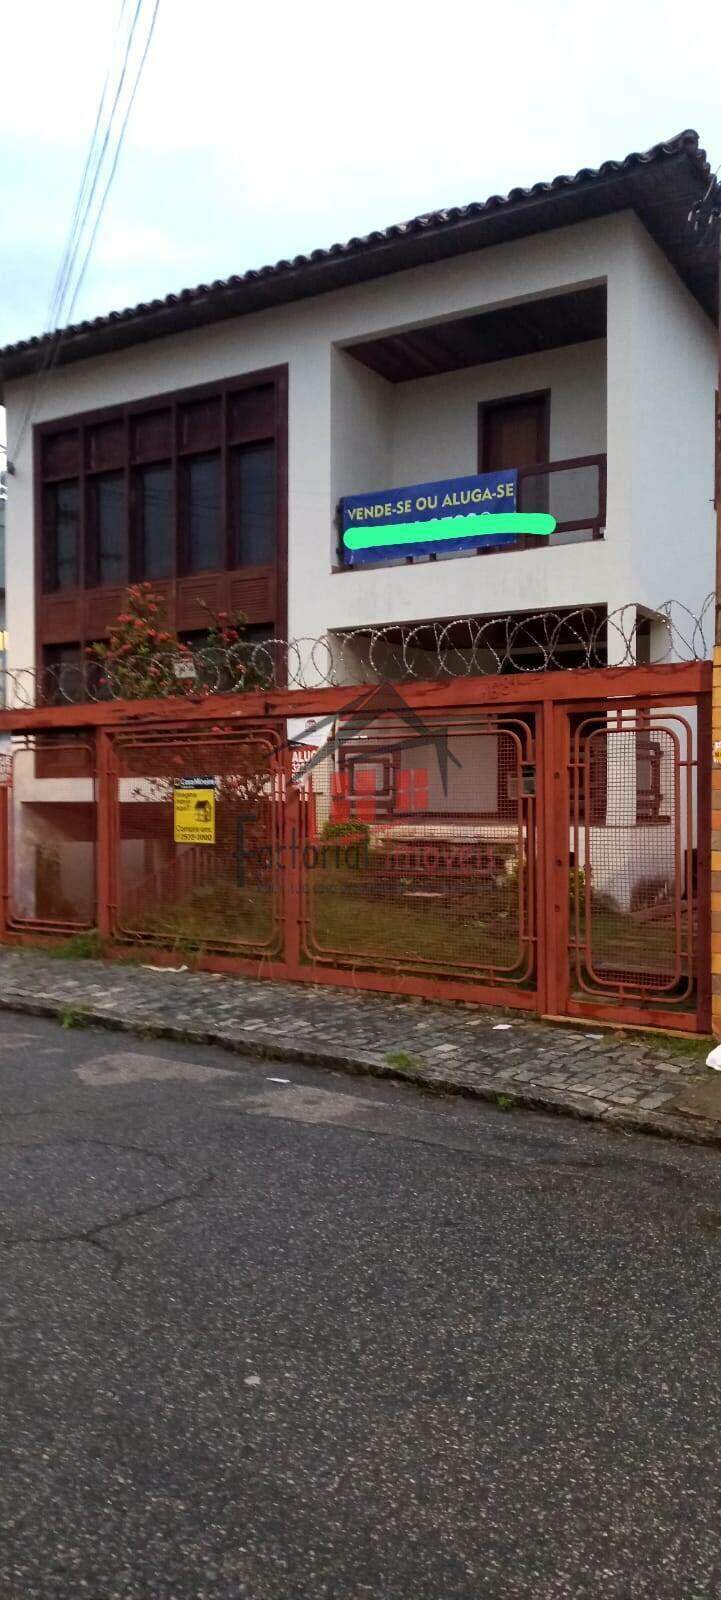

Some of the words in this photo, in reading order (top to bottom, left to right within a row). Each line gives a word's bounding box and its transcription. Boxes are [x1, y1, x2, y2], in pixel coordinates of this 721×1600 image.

[347, 499, 412, 521] VENDE-SE
[415, 496, 438, 511] OU
[441, 482, 514, 507] ALUGA-SE
